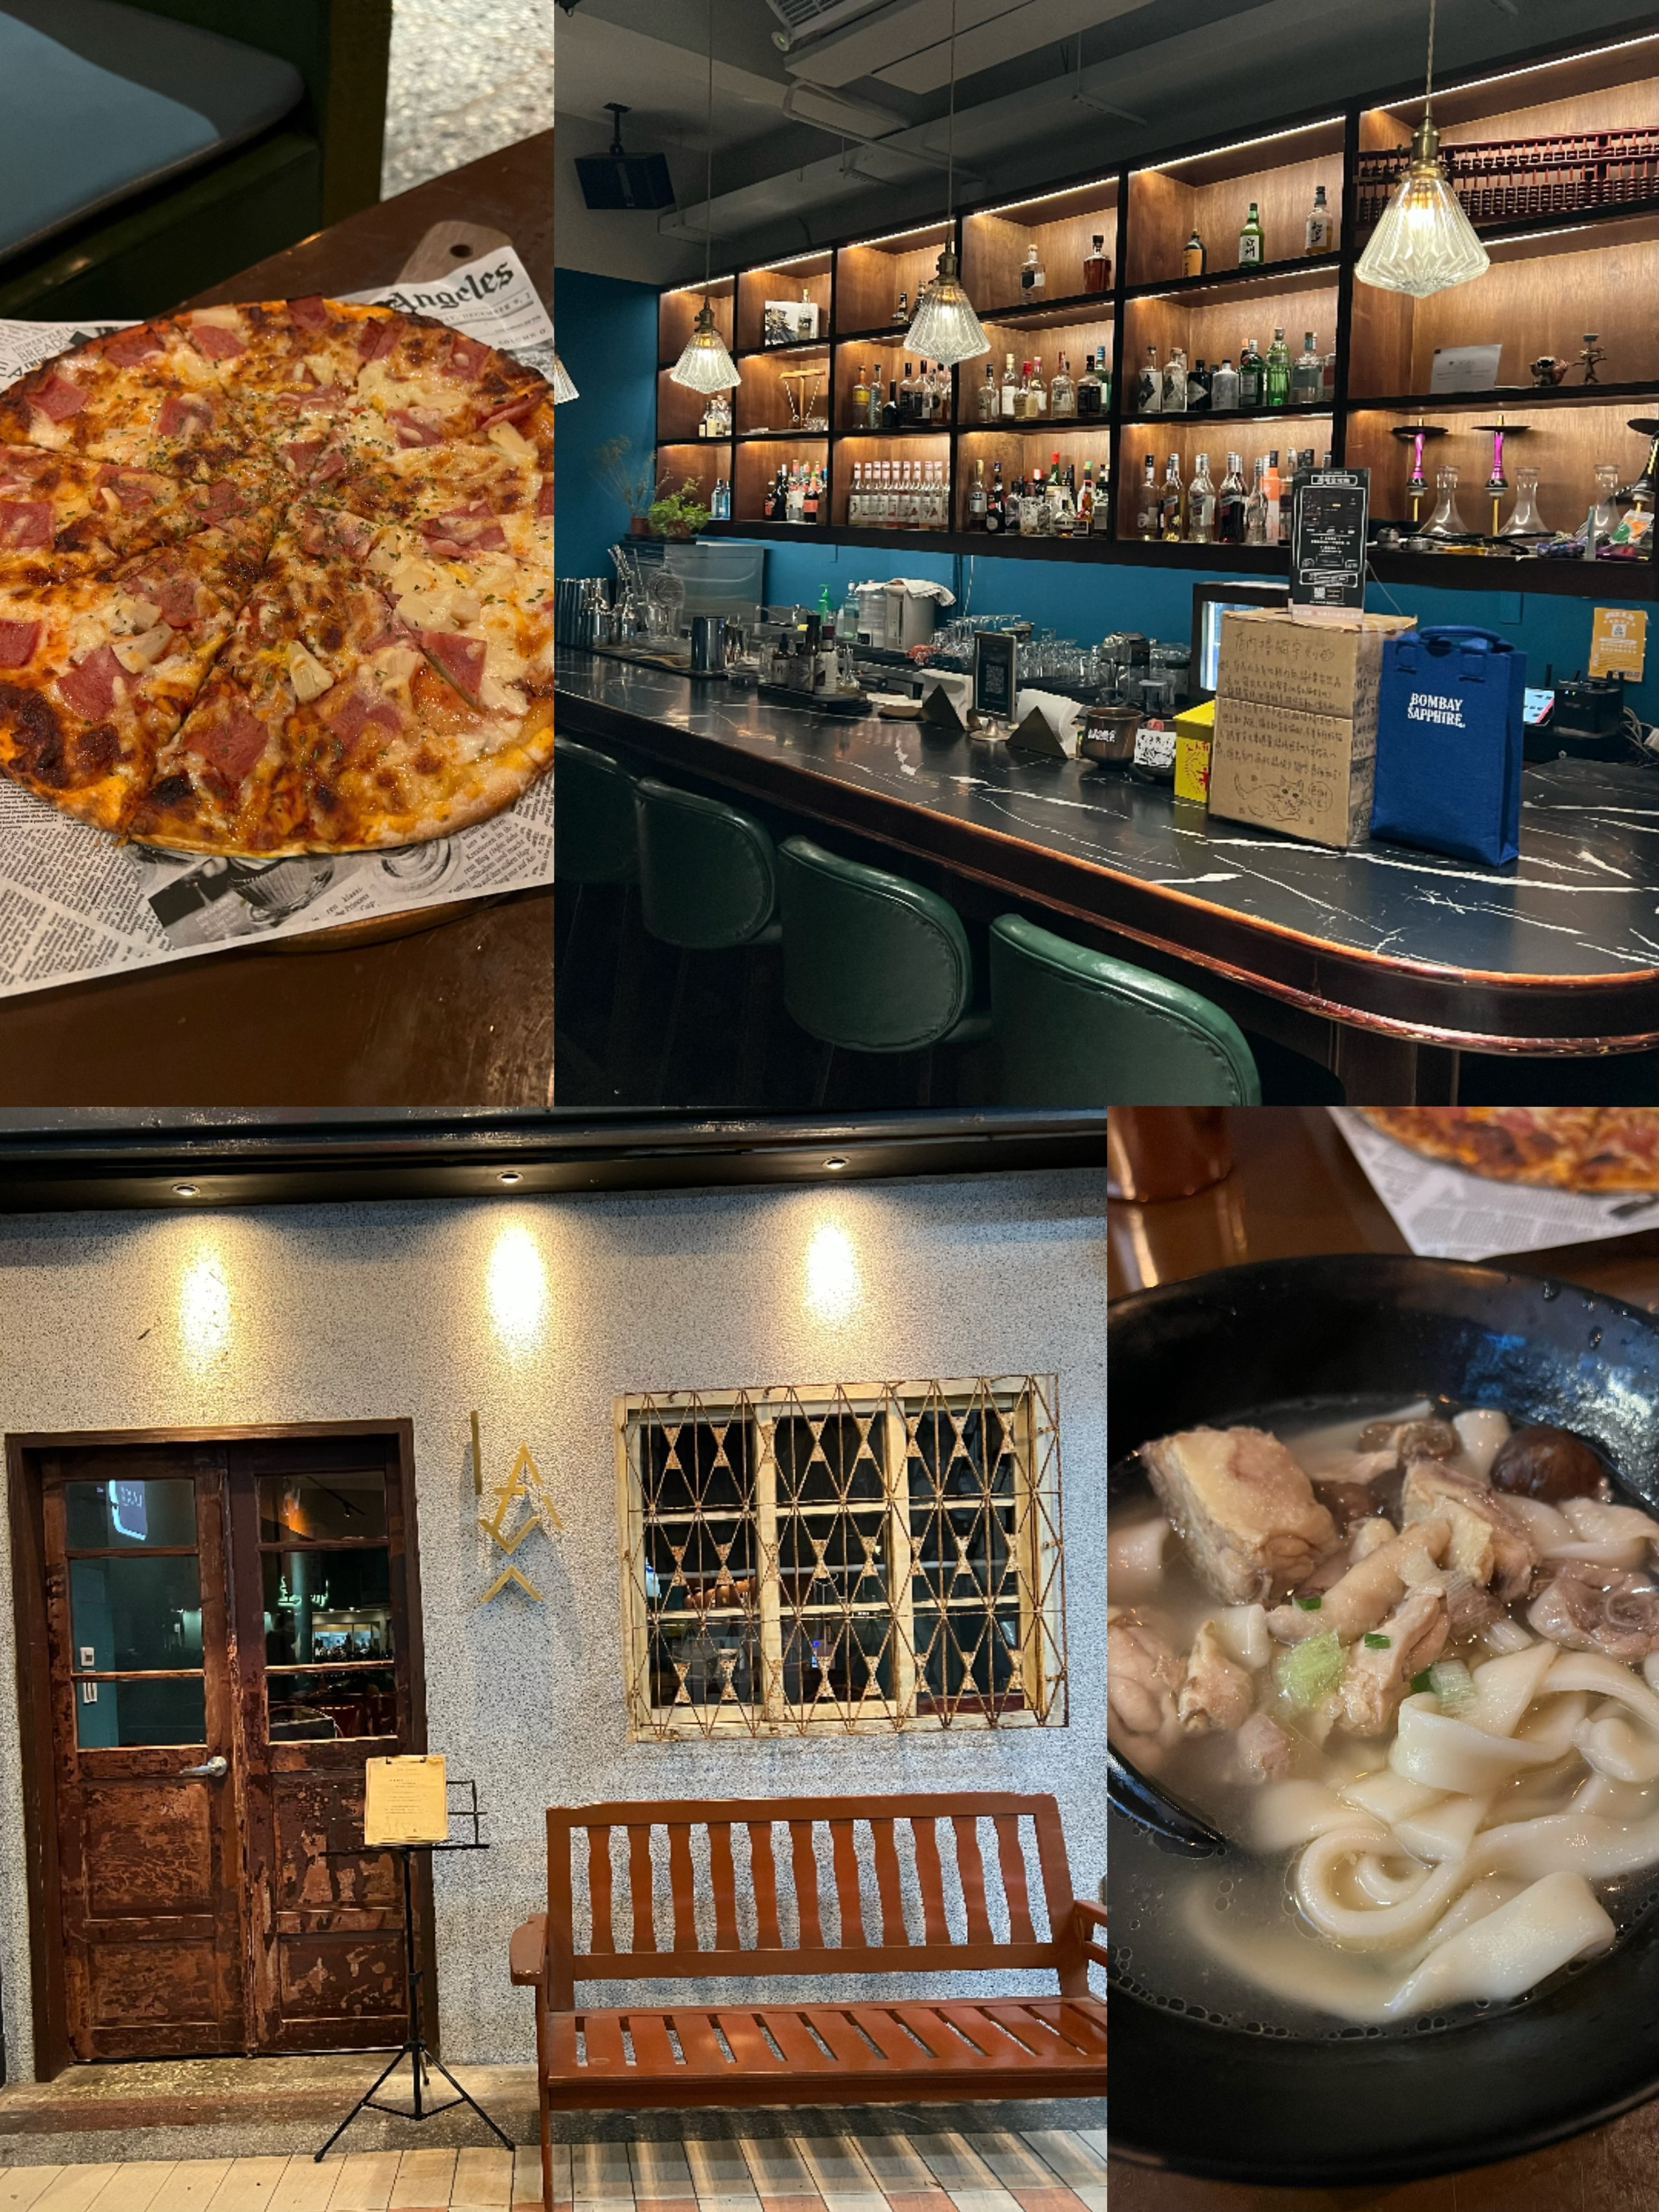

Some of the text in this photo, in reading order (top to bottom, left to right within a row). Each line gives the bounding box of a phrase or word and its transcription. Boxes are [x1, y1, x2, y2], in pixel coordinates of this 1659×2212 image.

[374, 262, 514, 314] Angeles
[463, 304, 510, 319] DECEMBER
[12, 329, 62, 352] HOMESTYLE
[1409, 693, 1463, 711] BOMBAY
[1407, 707, 1462, 727] SAPPHIRE
[465, 816, 507, 849] uns an ihren
[465, 836, 497, 861] Kreationen
[495, 830, 504, 839] in
[494, 851, 508, 863] und
[506, 838, 526, 855] macht
[474, 852, 491, 866] Blog
[66, 896, 75, 907] the
[71, 877, 86, 897] United
[94, 843, 105, 858] They
[479, 873, 492, 885] auf
[48, 888, 57, 899] the
[54, 877, 63, 889] first
[94, 860, 125, 911] They did not have
[72, 896, 83, 911] their
[78, 899, 89, 914] their
[84, 905, 93, 917] the
[96, 911, 105, 921] the
[102, 891, 116, 910] young
[325, 903, 339, 915] ren
[343, 893, 371, 912] Princess
[120, 923, 129, 933] up
[54, 955, 67, 971] They
